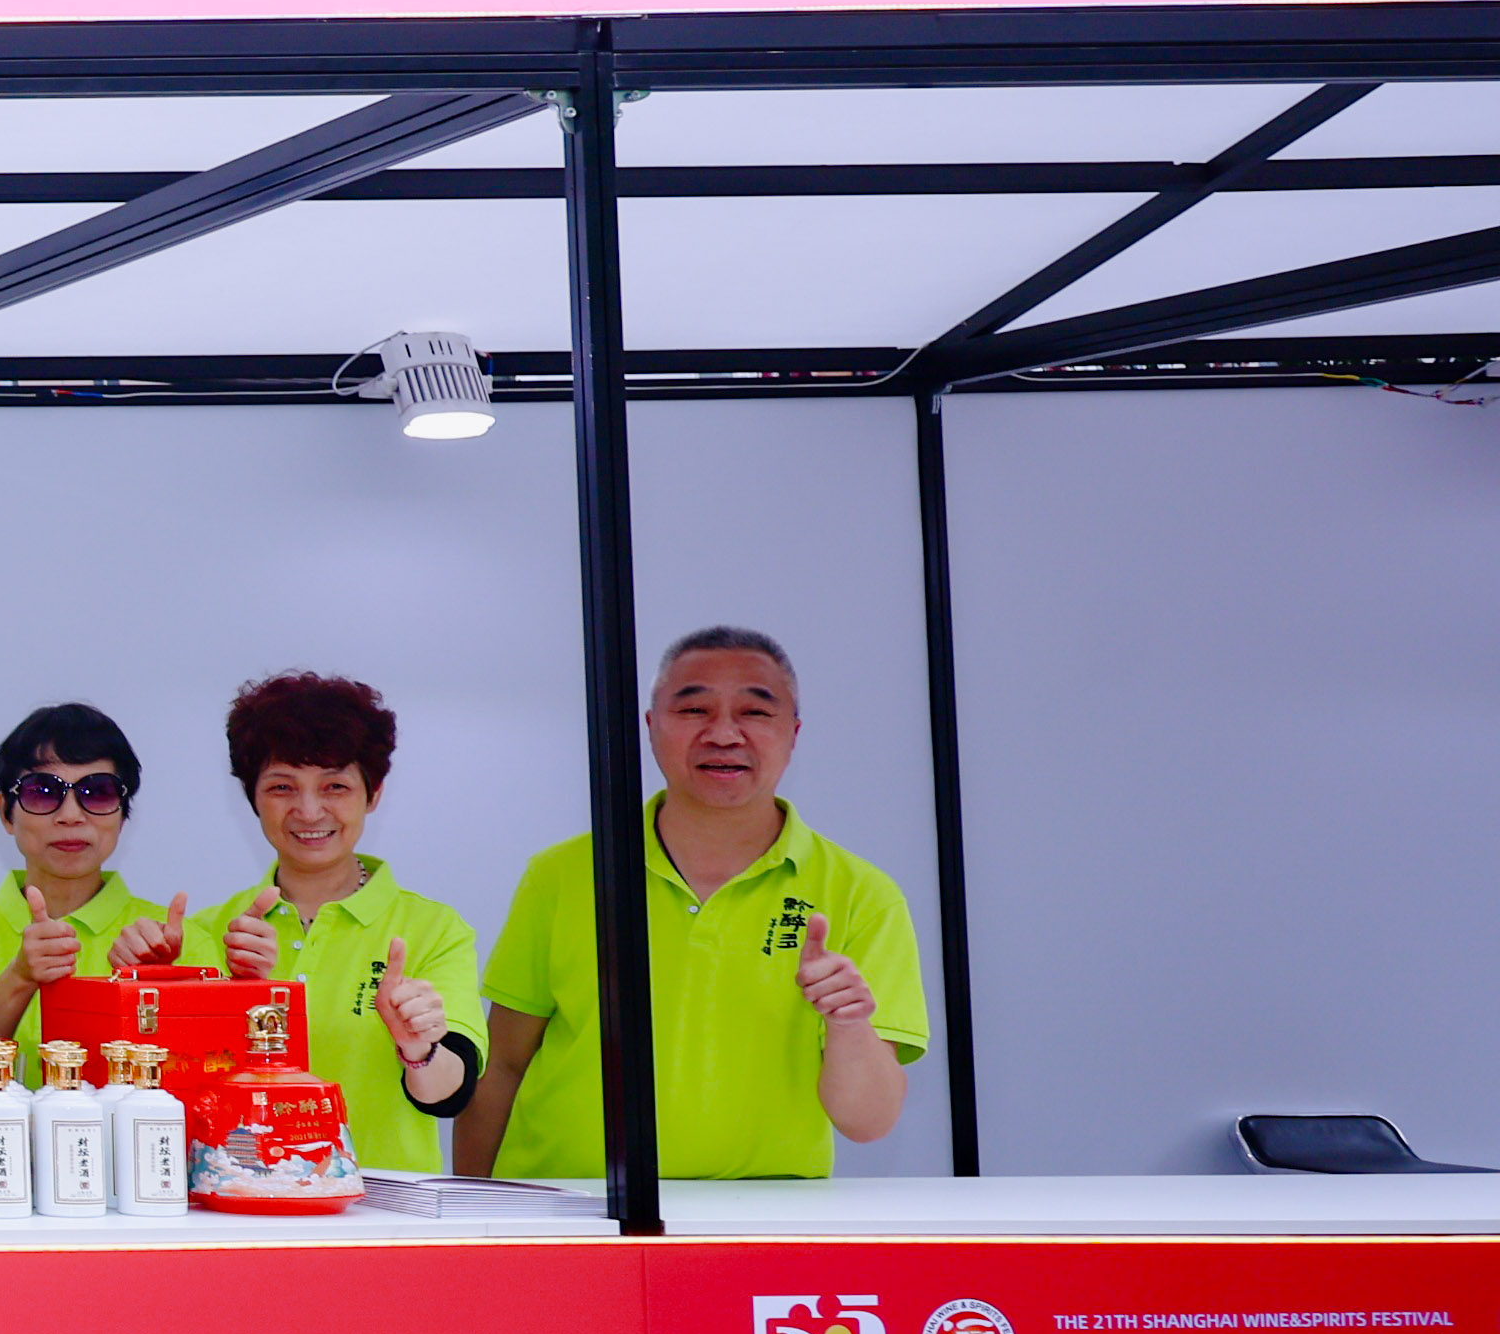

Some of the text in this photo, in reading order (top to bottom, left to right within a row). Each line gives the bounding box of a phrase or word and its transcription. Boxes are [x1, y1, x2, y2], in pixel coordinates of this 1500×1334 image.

[77, 1137, 90, 1179] 封坛老酒
[158, 1136, 172, 1178] 封坛老酒
[1054, 1311, 1454, 1330] THE 21TH SHANGHAI WINE&SPIRITS FESTIVAL
